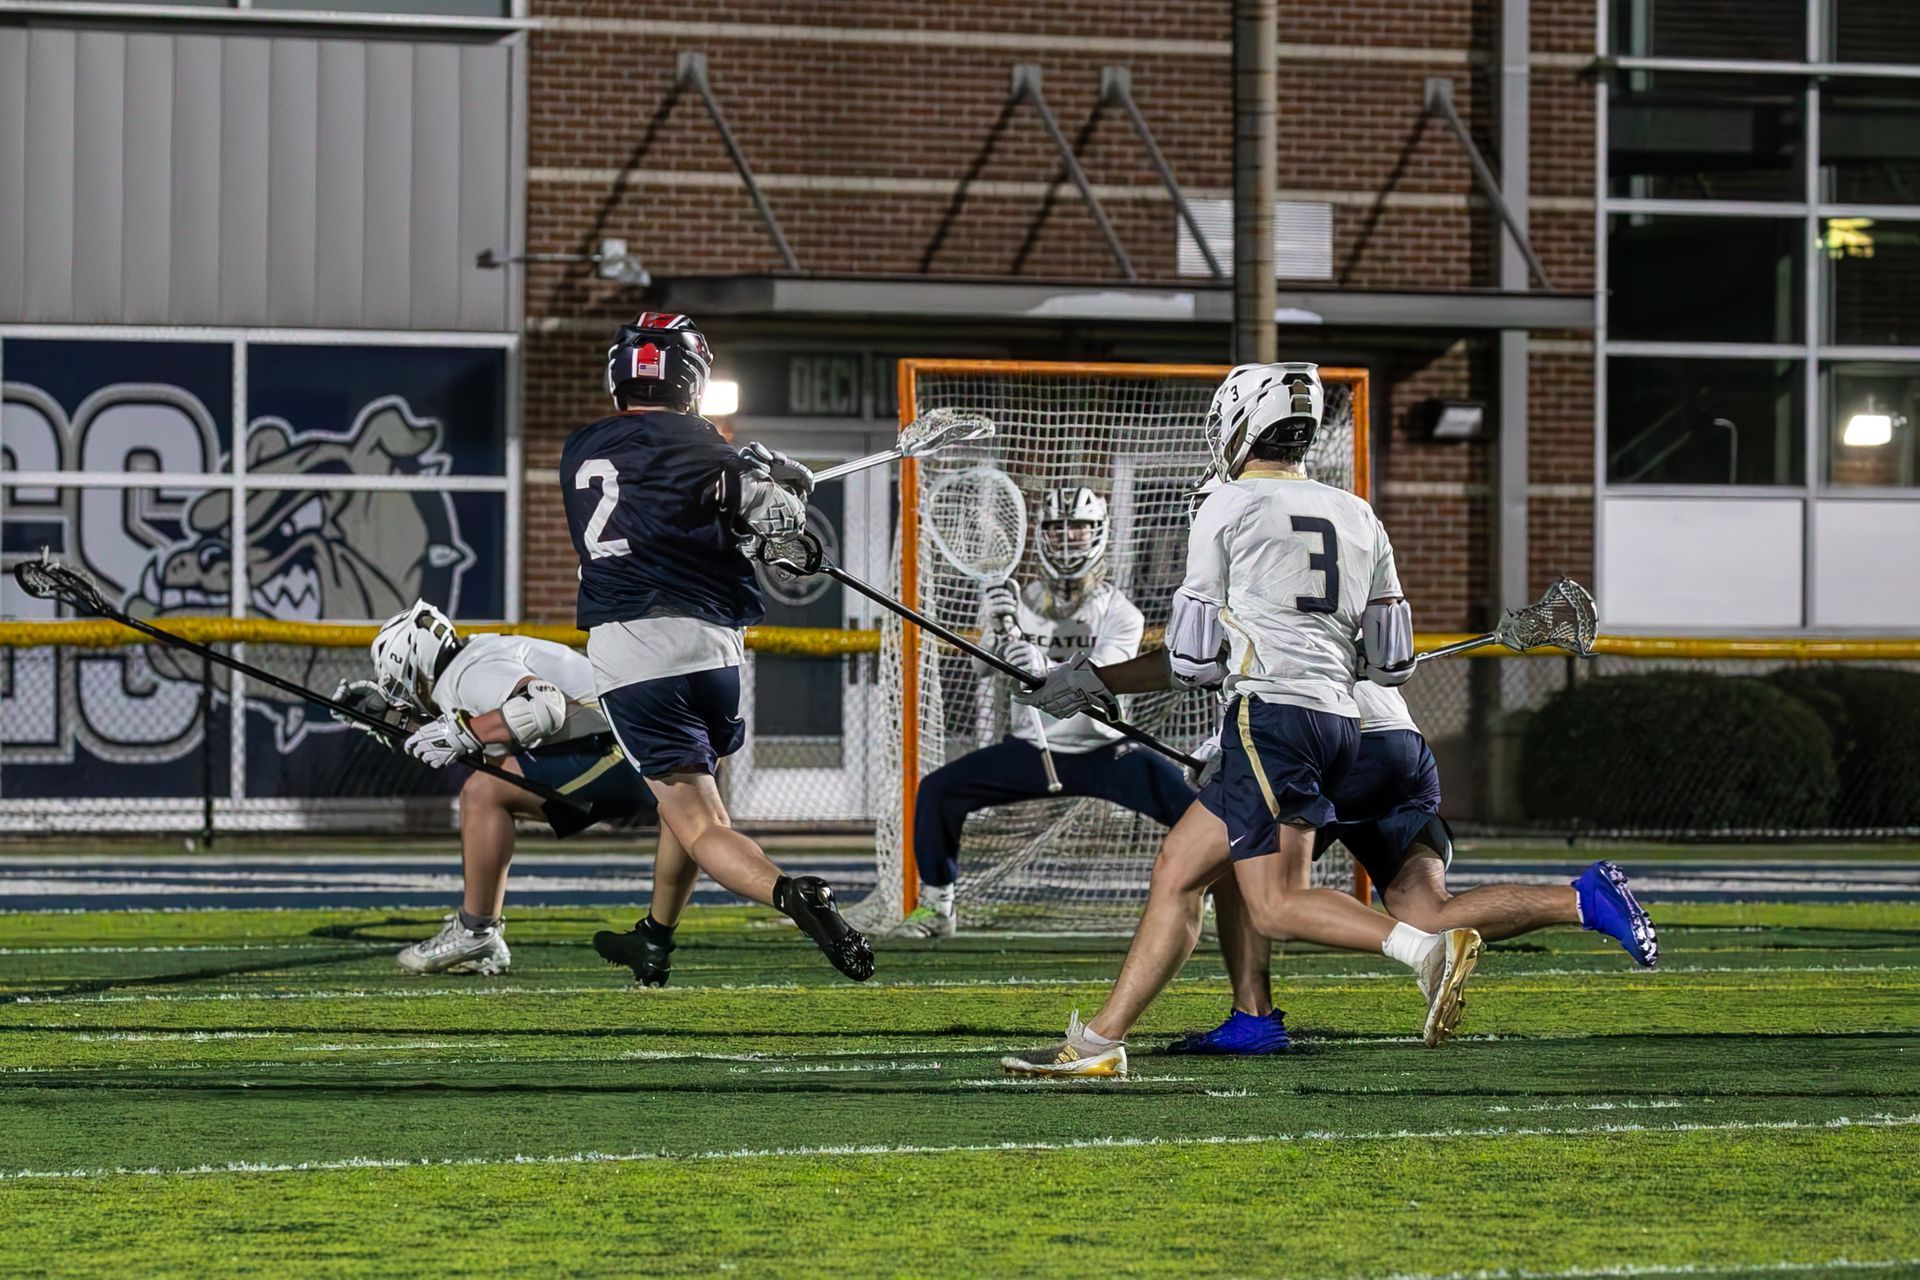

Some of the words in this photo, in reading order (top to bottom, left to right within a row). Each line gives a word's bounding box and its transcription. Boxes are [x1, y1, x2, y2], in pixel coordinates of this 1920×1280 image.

[1230, 384, 1240, 402] 3
[575, 458, 632, 560] 2
[1289, 515, 1340, 614] 3
[1020, 632, 1098, 649] ECATU
[390, 652, 403, 665] 2
